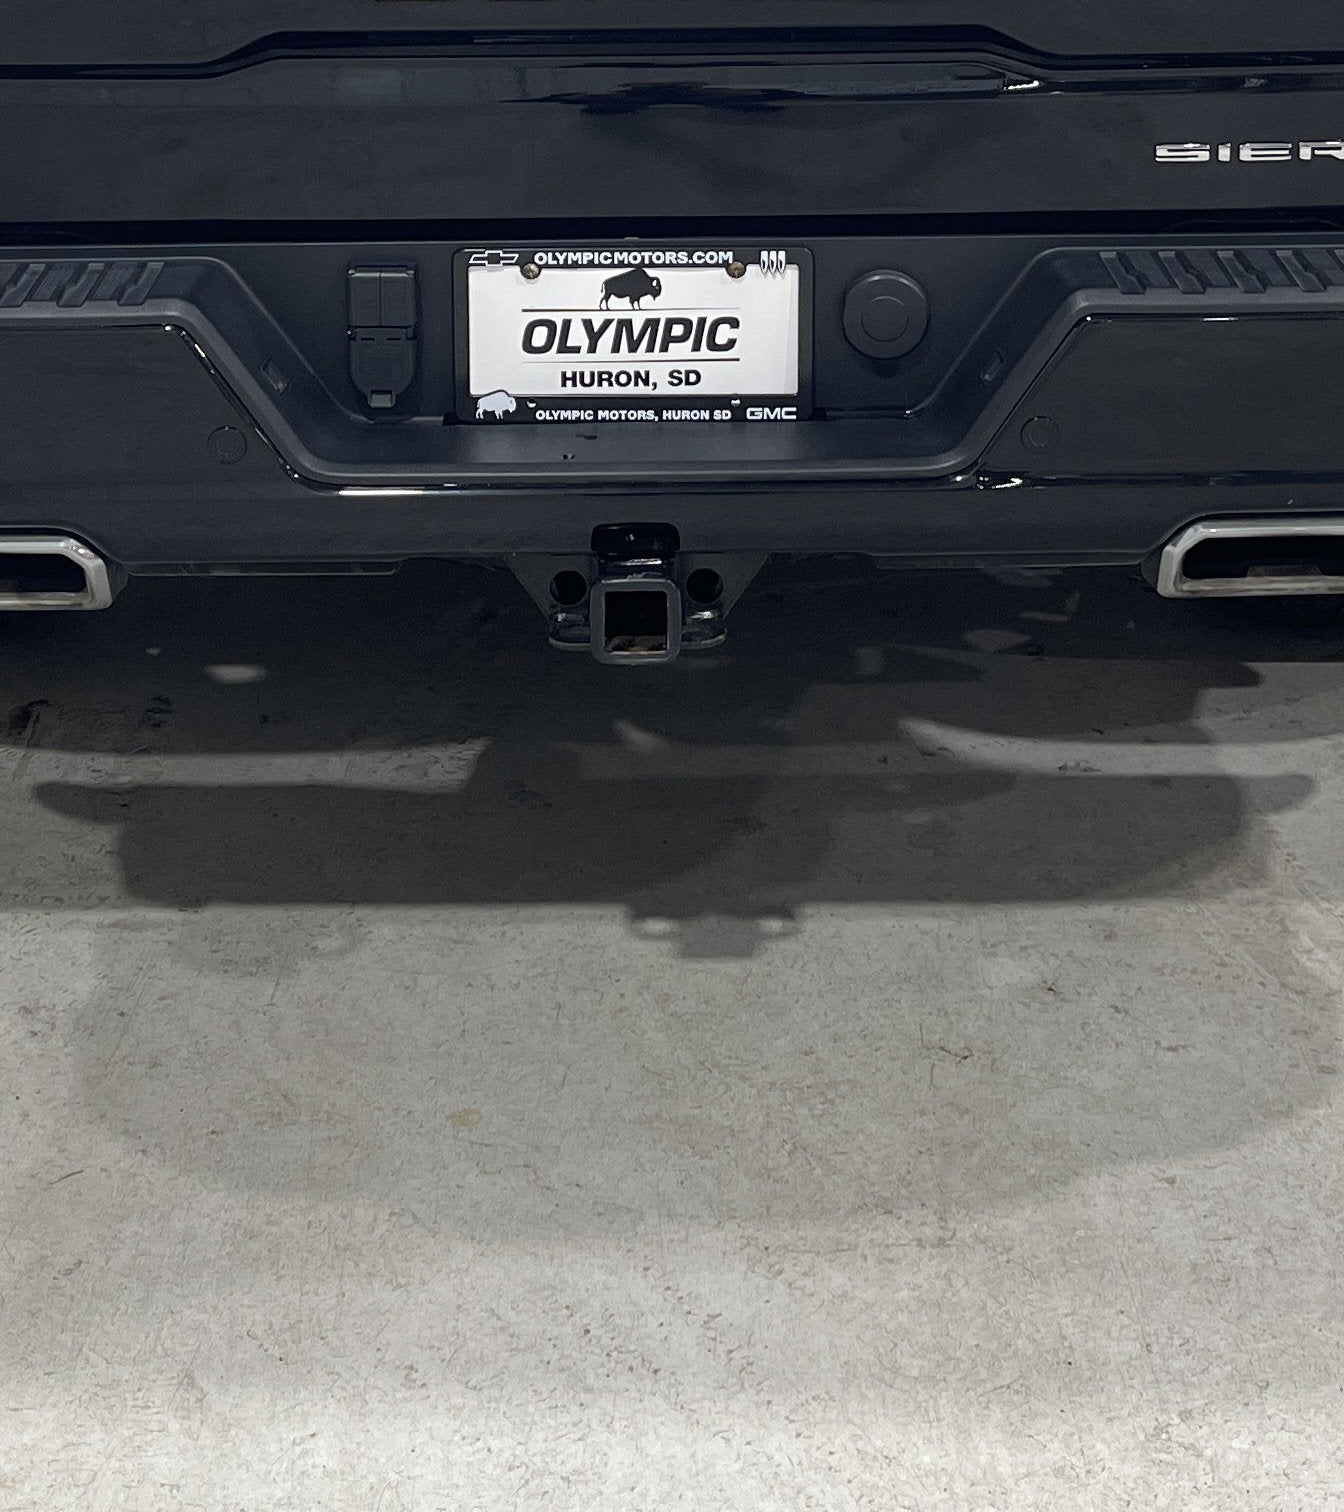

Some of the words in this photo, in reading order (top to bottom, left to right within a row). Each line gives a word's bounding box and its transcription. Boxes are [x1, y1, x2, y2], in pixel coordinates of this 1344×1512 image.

[533, 250, 733, 266] OLYMPICMOTORS.COM
[521, 316, 741, 355] OLYMPIC
[560, 369, 658, 391] HURON,
[667, 369, 702, 387] SD
[535, 409, 594, 421] OLYMPIC
[597, 409, 659, 422] MOTORS,
[662, 409, 710, 421] HURON
[713, 409, 732, 421] SD
[745, 406, 798, 421] GMC
